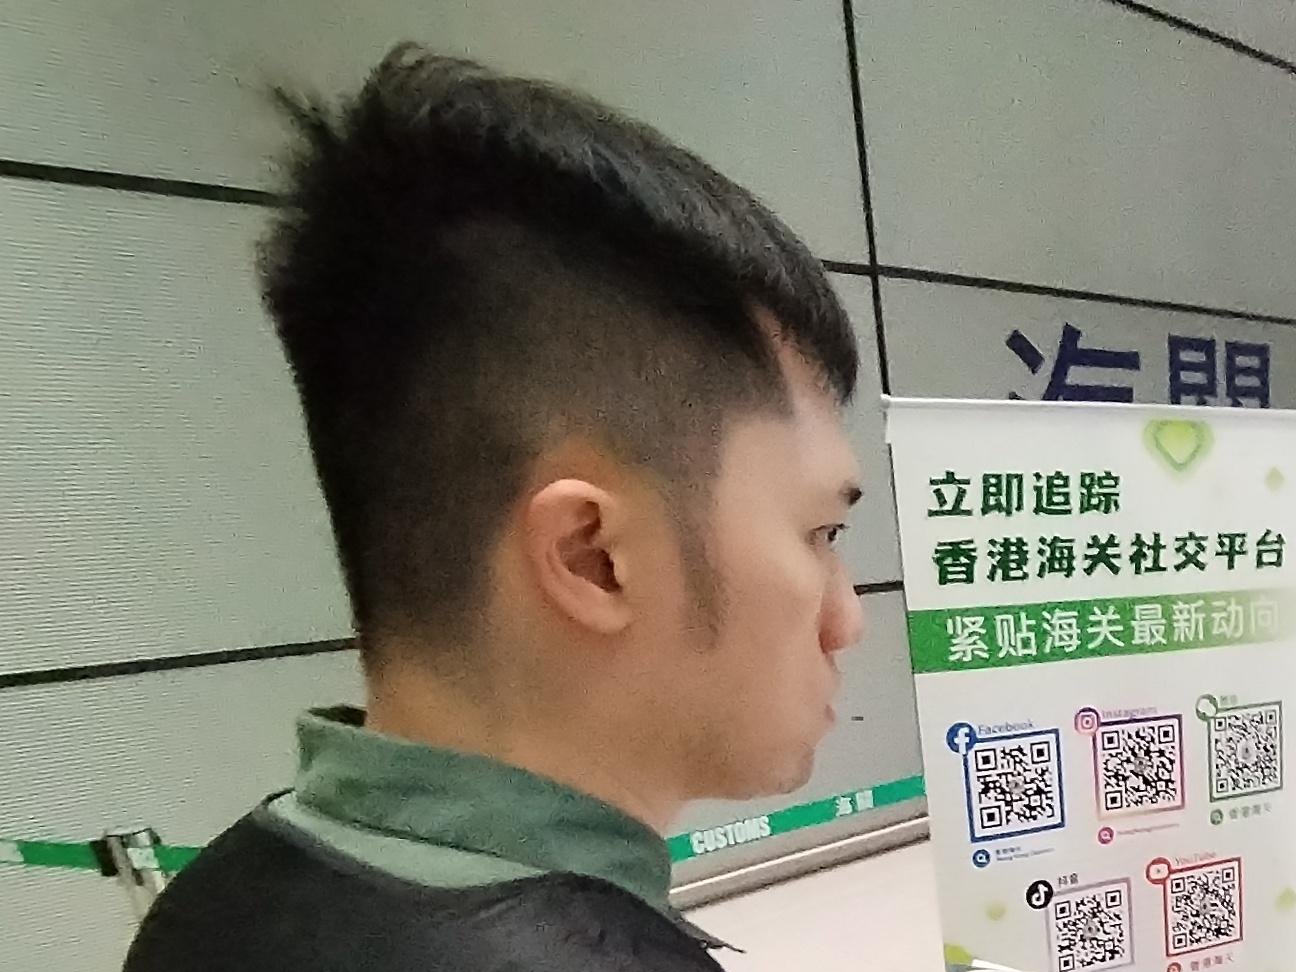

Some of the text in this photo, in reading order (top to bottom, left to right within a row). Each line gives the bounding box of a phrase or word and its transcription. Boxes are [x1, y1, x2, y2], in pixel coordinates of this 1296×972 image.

[927, 470, 1121, 517] 立即追踪
[932, 529, 1287, 585] 香港海关社交平台
[945, 599, 1280, 662] 紧贴海关最新动向
[977, 718, 1034, 735] Facebook
[691, 815, 771, 855] CUSTOMS
